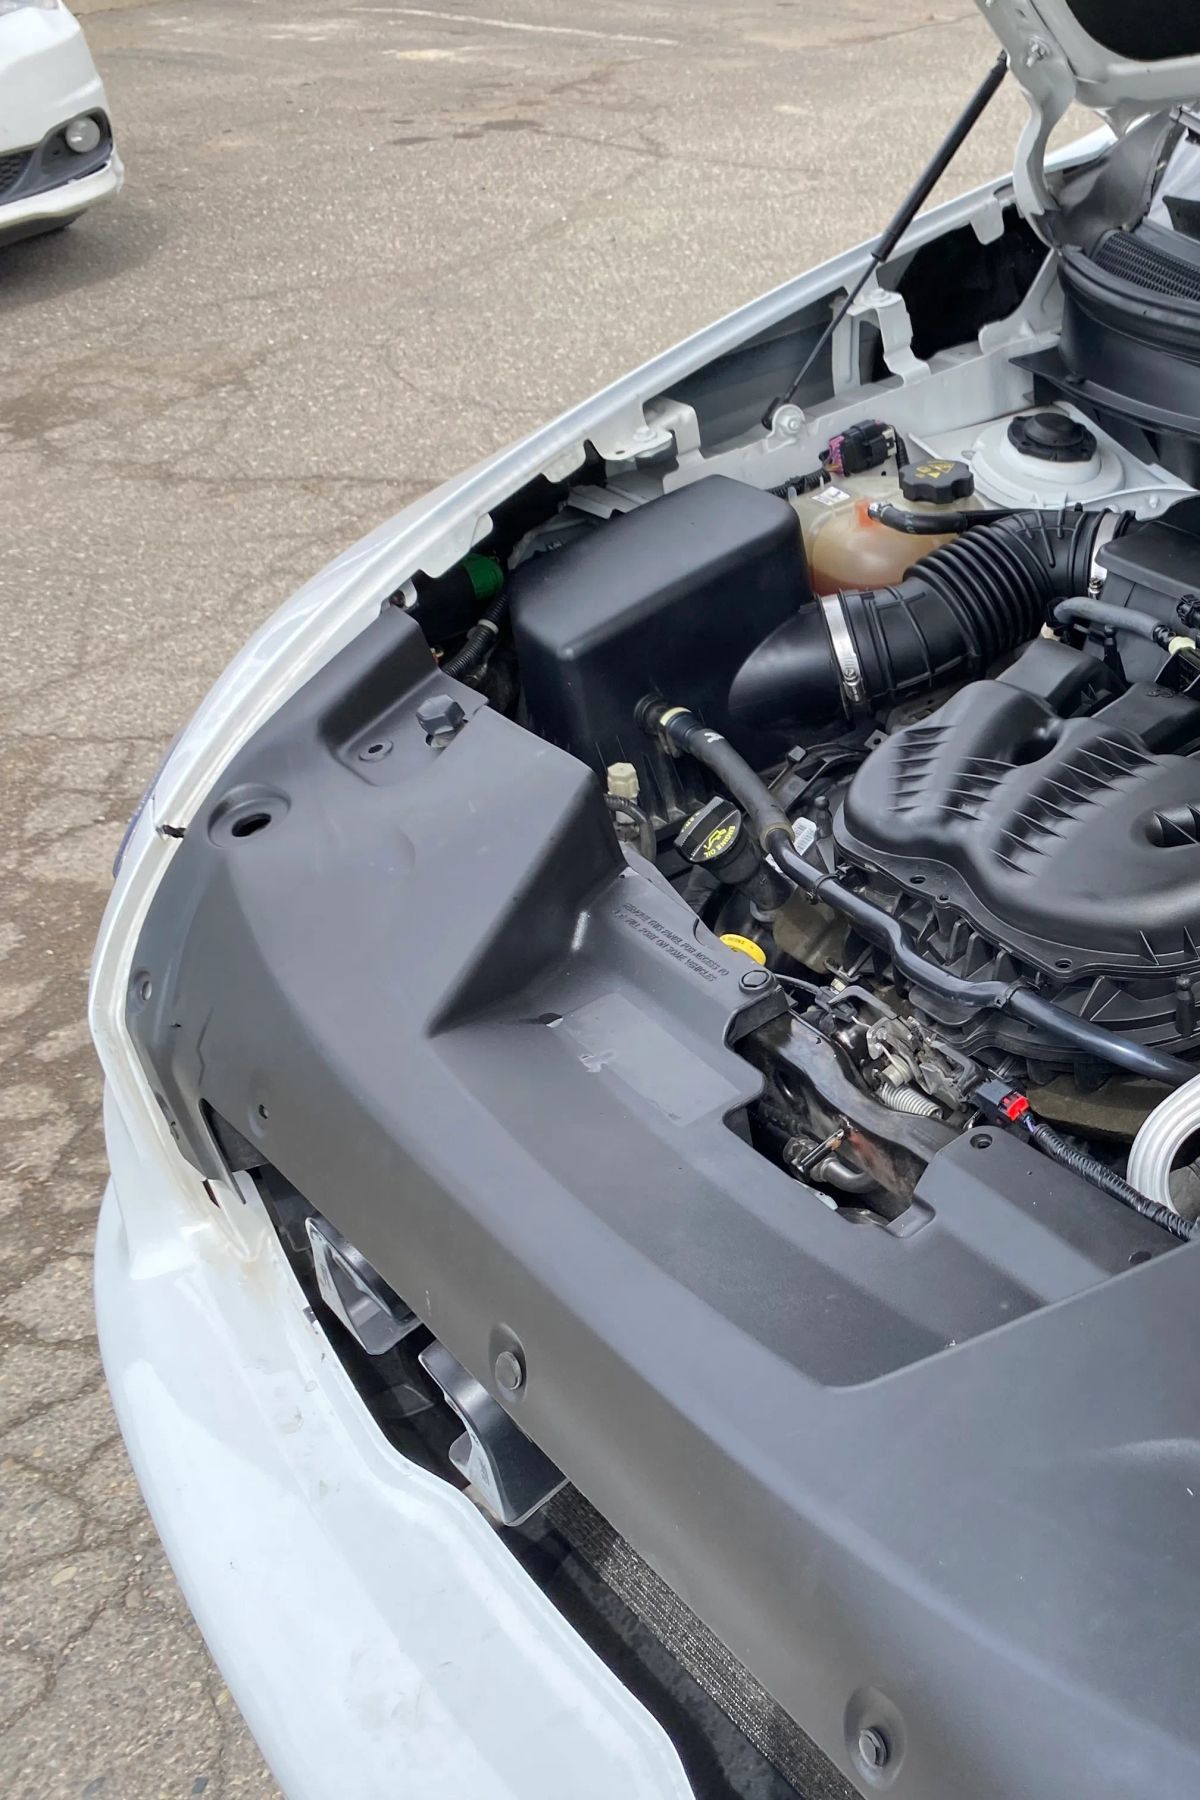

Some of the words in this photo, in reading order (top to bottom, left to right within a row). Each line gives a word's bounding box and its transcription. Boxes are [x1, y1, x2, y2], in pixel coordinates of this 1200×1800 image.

[703, 847, 716, 858] OIL
[715, 825, 735, 850] ENGINE
[647, 919, 664, 930] THIS
[660, 929, 683, 944] PANEL
[680, 942, 696, 953] FOR
[695, 953, 720, 970] ACCESS
[718, 969, 730, 977] TO
[656, 940, 669, 948] ON
[665, 947, 686, 961] SOME
[685, 960, 717, 983] VEHICLES
